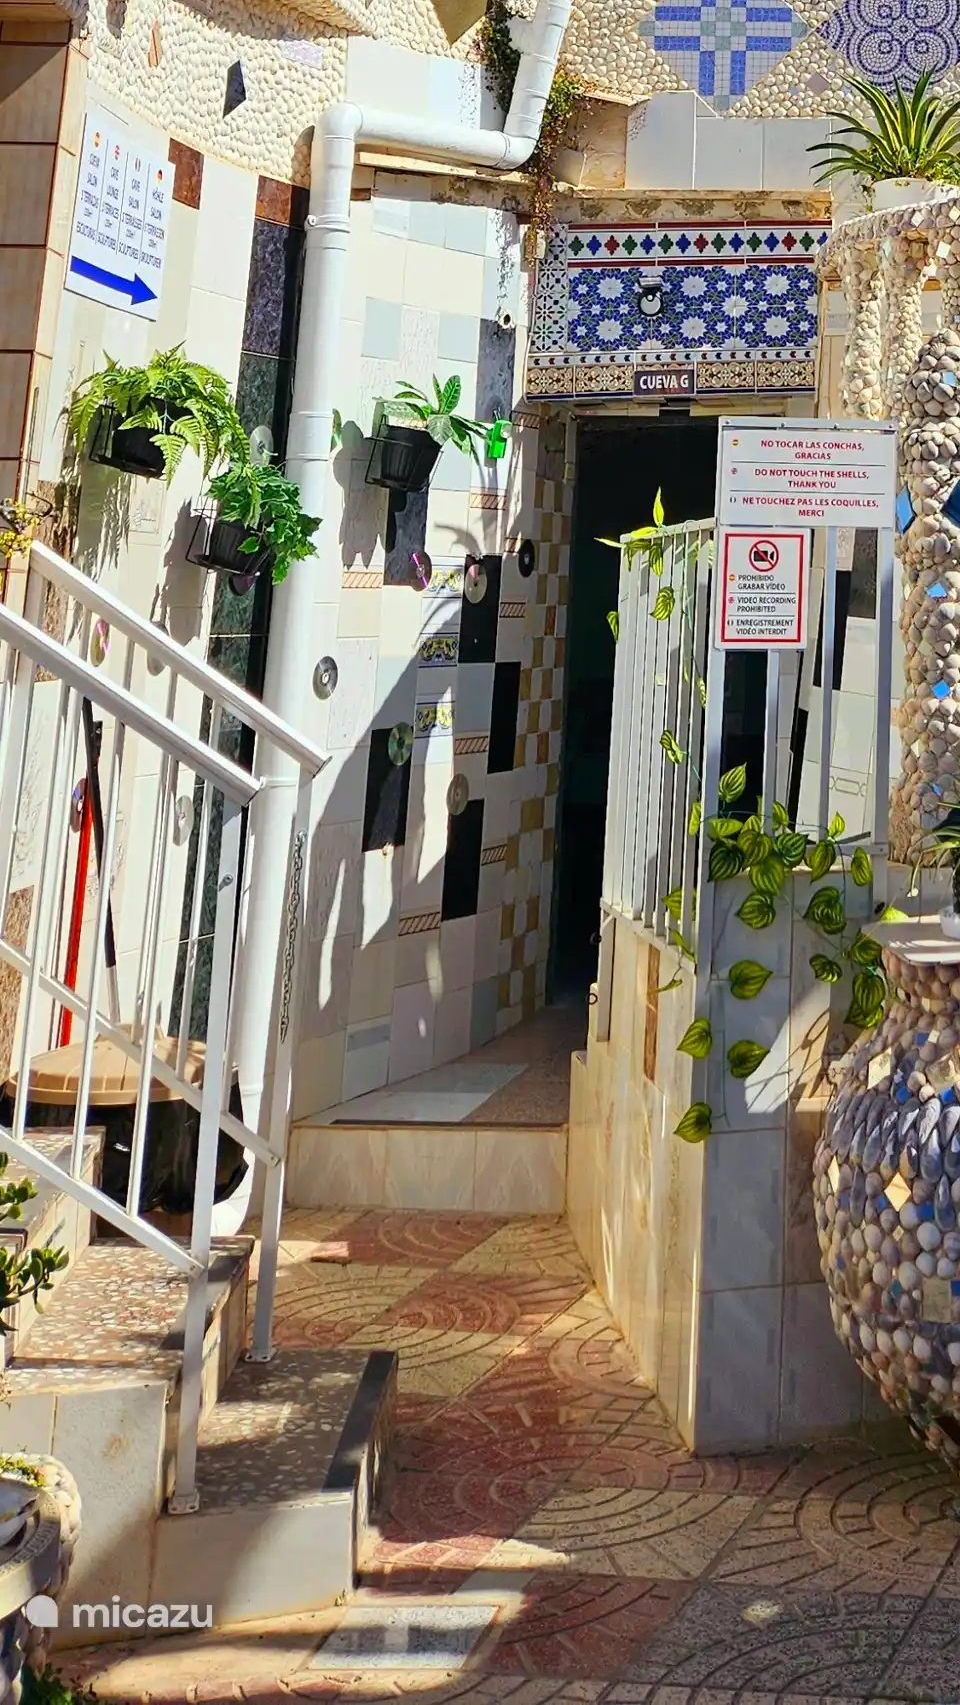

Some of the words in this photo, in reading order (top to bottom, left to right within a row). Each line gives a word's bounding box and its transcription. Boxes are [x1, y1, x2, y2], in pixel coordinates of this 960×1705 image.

[640, 375, 678, 389] CUEVA
[680, 375, 689, 388] G
[823, 442, 864, 451] CONCHAS,
[788, 469, 817, 477] TOUCH
[837, 471, 869, 479] SHELLS,
[831, 499, 879, 508] COQUILLES,
